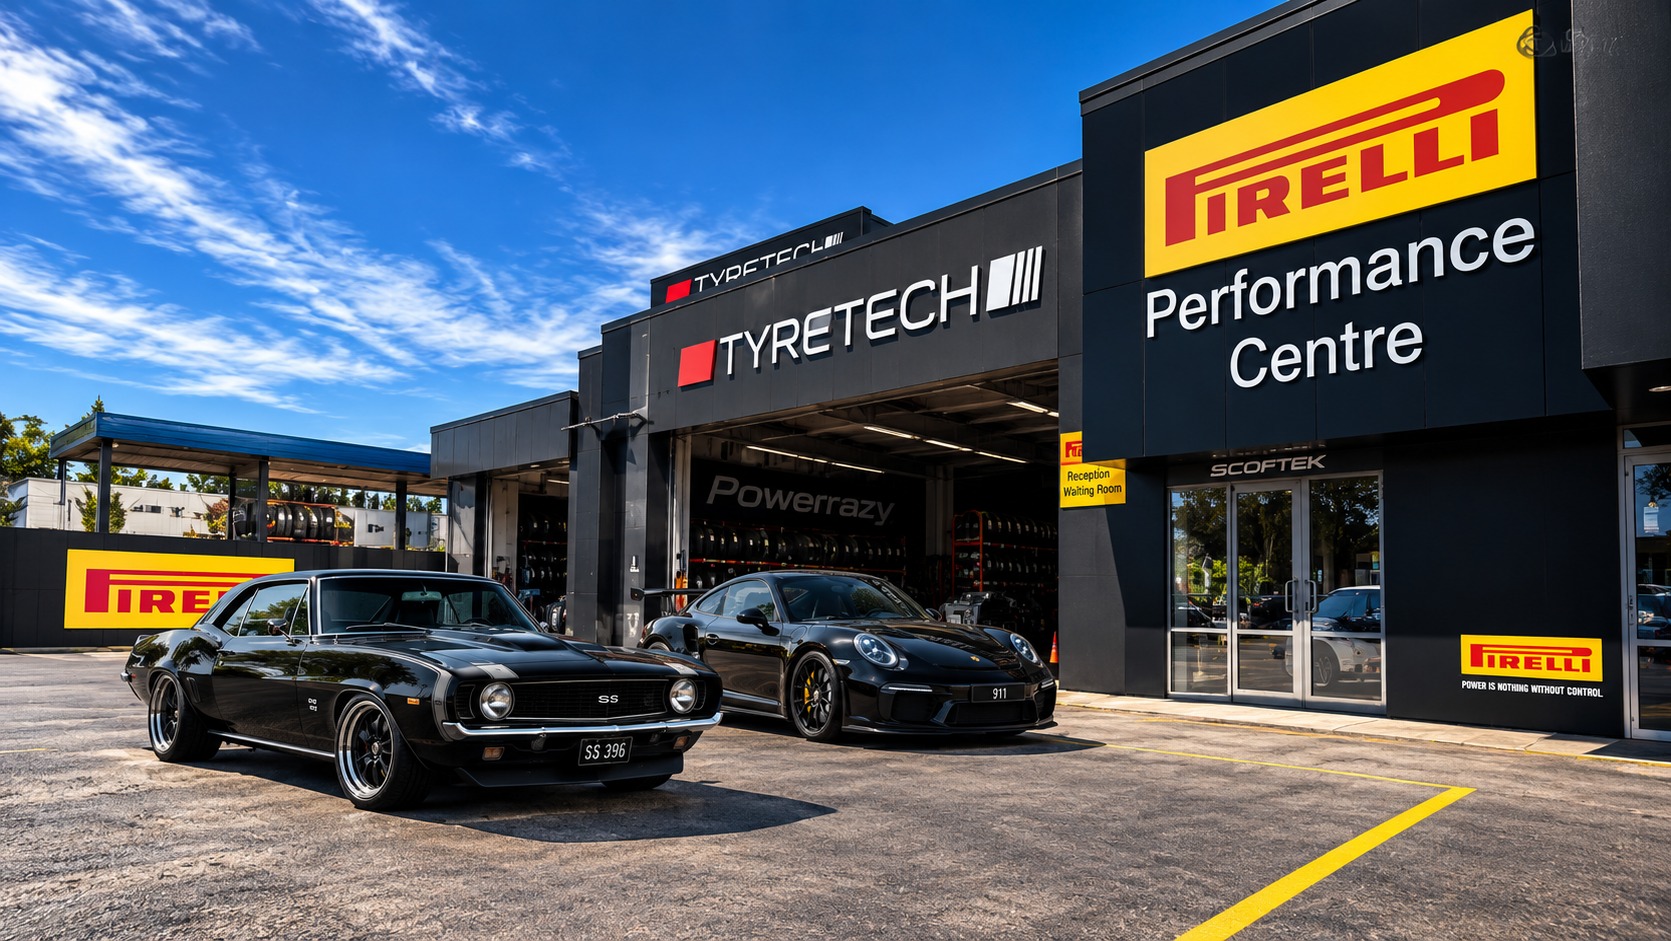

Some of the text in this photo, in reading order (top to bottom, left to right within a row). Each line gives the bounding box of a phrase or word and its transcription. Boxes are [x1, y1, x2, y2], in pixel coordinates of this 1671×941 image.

[1165, 69, 1505, 247] PIRELLI
[1146, 217, 1536, 338] Performance
[719, 265, 979, 376] TYRETECH
[1230, 321, 1424, 389] Centre
[1067, 467, 1110, 482] Reception
[1210, 454, 1327, 478] SCOFTEK
[706, 474, 896, 527] Powerrazy
[1063, 484, 1122, 498] Waiting Room
[84, 568, 272, 613] PIRE
[1470, 643, 1593, 673] PIRELLI
[598, 694, 619, 704] SS
[992, 687, 1007, 700] 911
[1461, 680, 1604, 698] POWER IS NOTHING WITHOUT CONTROL
[584, 742, 627, 760] SS 396
